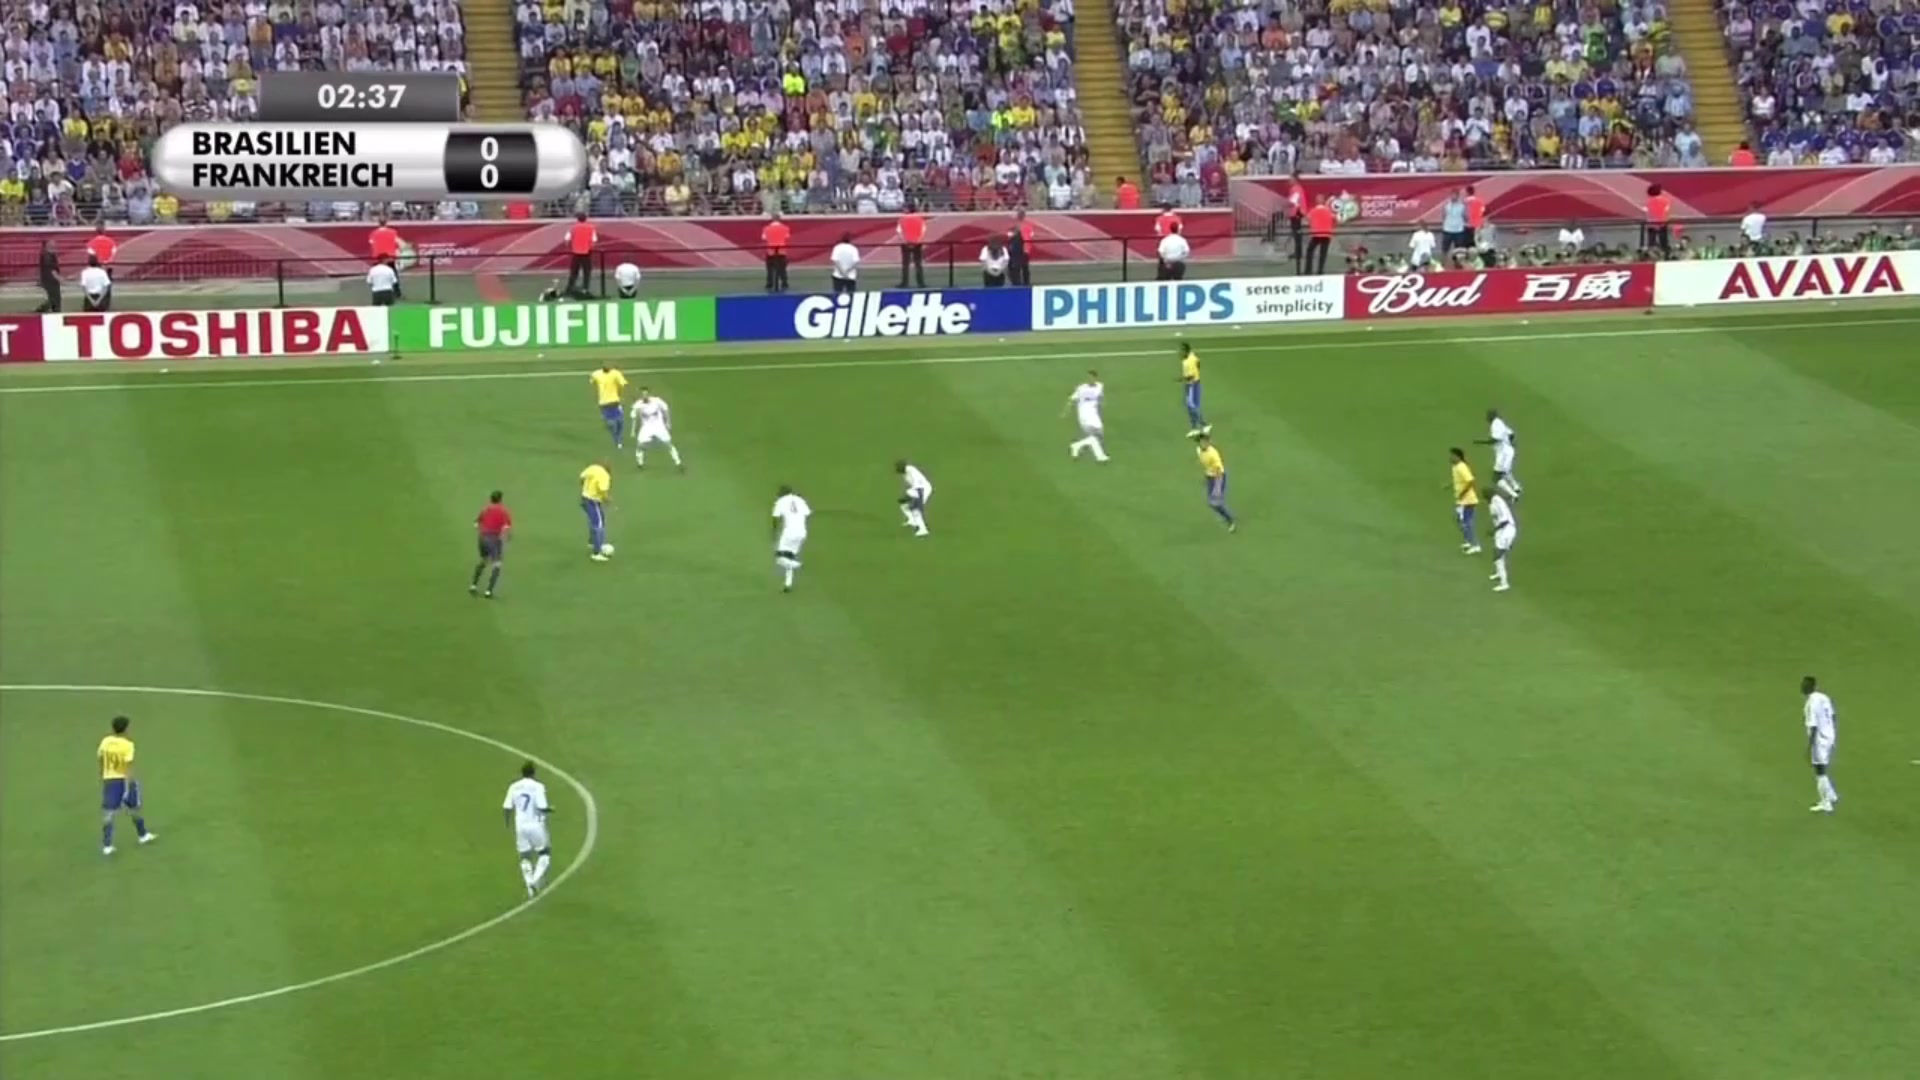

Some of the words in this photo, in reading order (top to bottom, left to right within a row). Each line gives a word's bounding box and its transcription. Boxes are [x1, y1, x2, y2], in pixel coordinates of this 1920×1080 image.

[1245, 283, 1290, 296] sense
[1294, 281, 1324, 294] and
[1356, 273, 1487, 314] Bud
[1516, 270, 1632, 303] 百威
[1721, 255, 1904, 300] AVAYA
[429, 301, 676, 347] FUJIFILM
[794, 293, 970, 339] Gillette
[1043, 282, 1234, 326] PHILIPS
[1255, 299, 1334, 316] simplicity
[64, 308, 369, 357] TOSHIBA
[520, 793, 531, 812] 7
